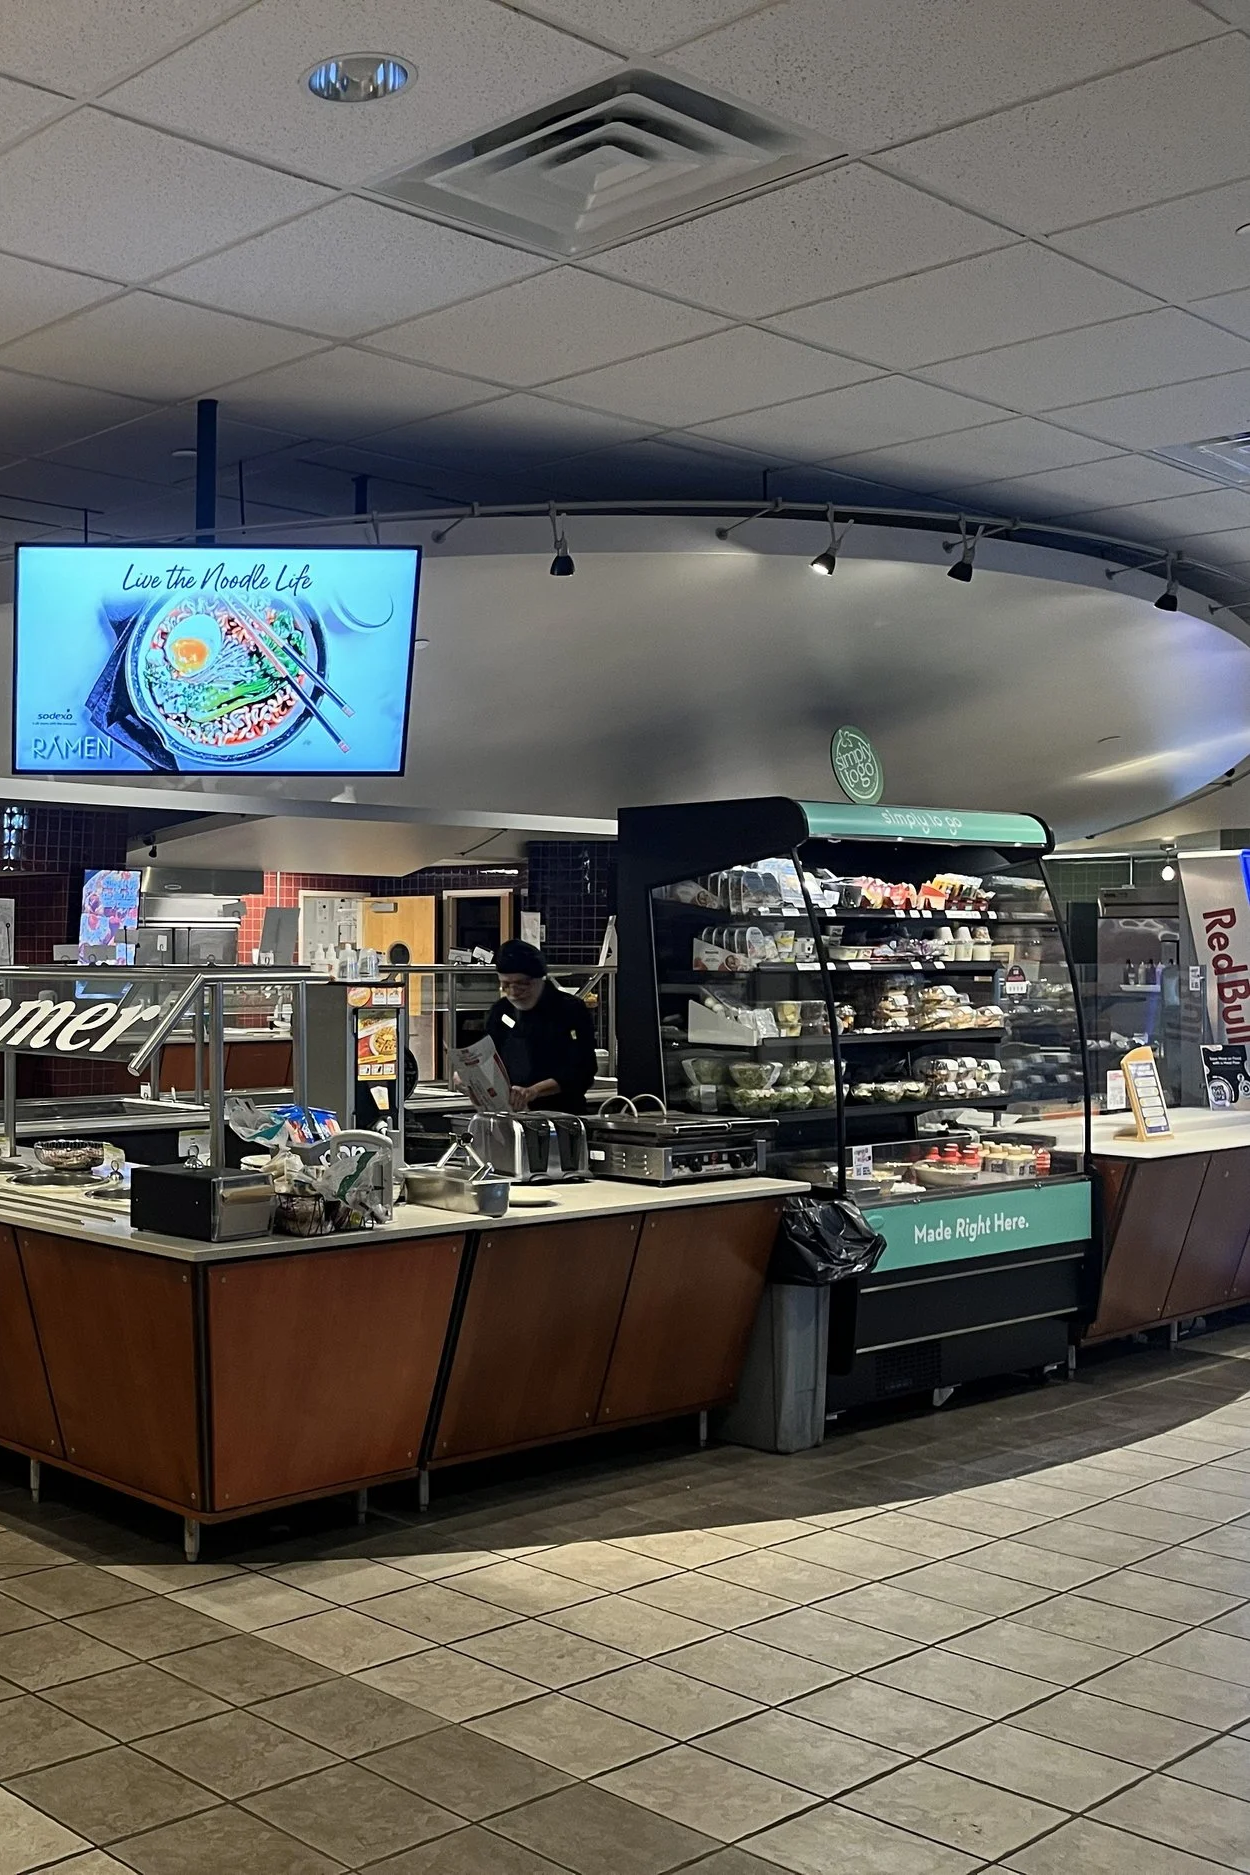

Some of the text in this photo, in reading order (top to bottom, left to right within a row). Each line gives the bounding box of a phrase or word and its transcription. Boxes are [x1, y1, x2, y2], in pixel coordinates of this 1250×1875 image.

[122, 562, 314, 596] Live the Noodle Life
[37, 709, 73, 720] sodexo
[32, 736, 113, 760] RAMEN
[836, 741, 872, 771] simply
[844, 762, 874, 788] to go
[881, 809, 962, 835] simply to go
[1202, 907, 1250, 1045] Red Bull
[914, 1212, 1029, 1245] Made Right Here.
